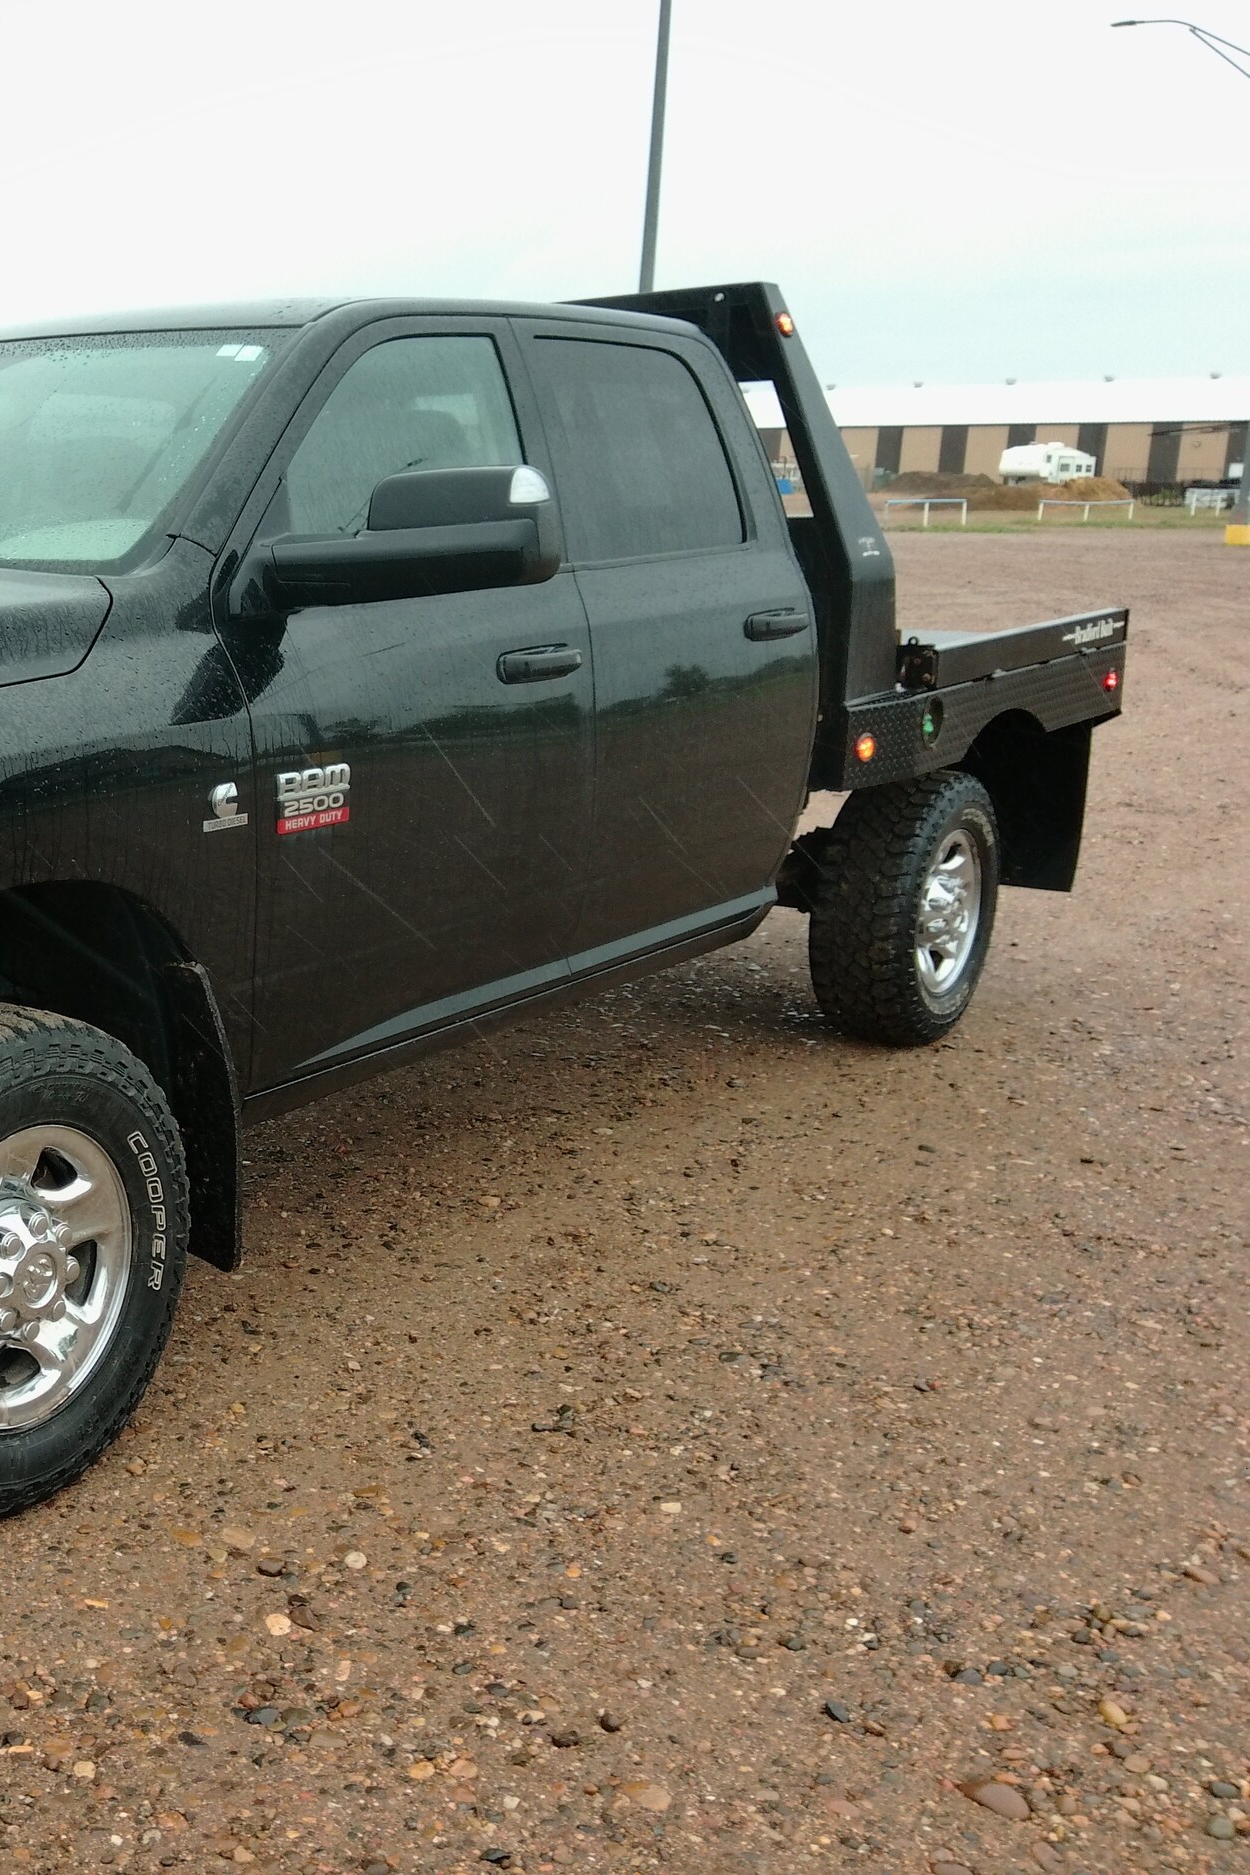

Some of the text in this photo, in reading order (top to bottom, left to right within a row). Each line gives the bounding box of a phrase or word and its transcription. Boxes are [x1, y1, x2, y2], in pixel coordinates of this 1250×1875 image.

[277, 763, 351, 801] RAM
[284, 792, 345, 817] 2500
[207, 816, 246, 830] TURBO DIESEL
[285, 811, 343, 830] HEAVY DUTY
[127, 1131, 167, 1291] COOPER
